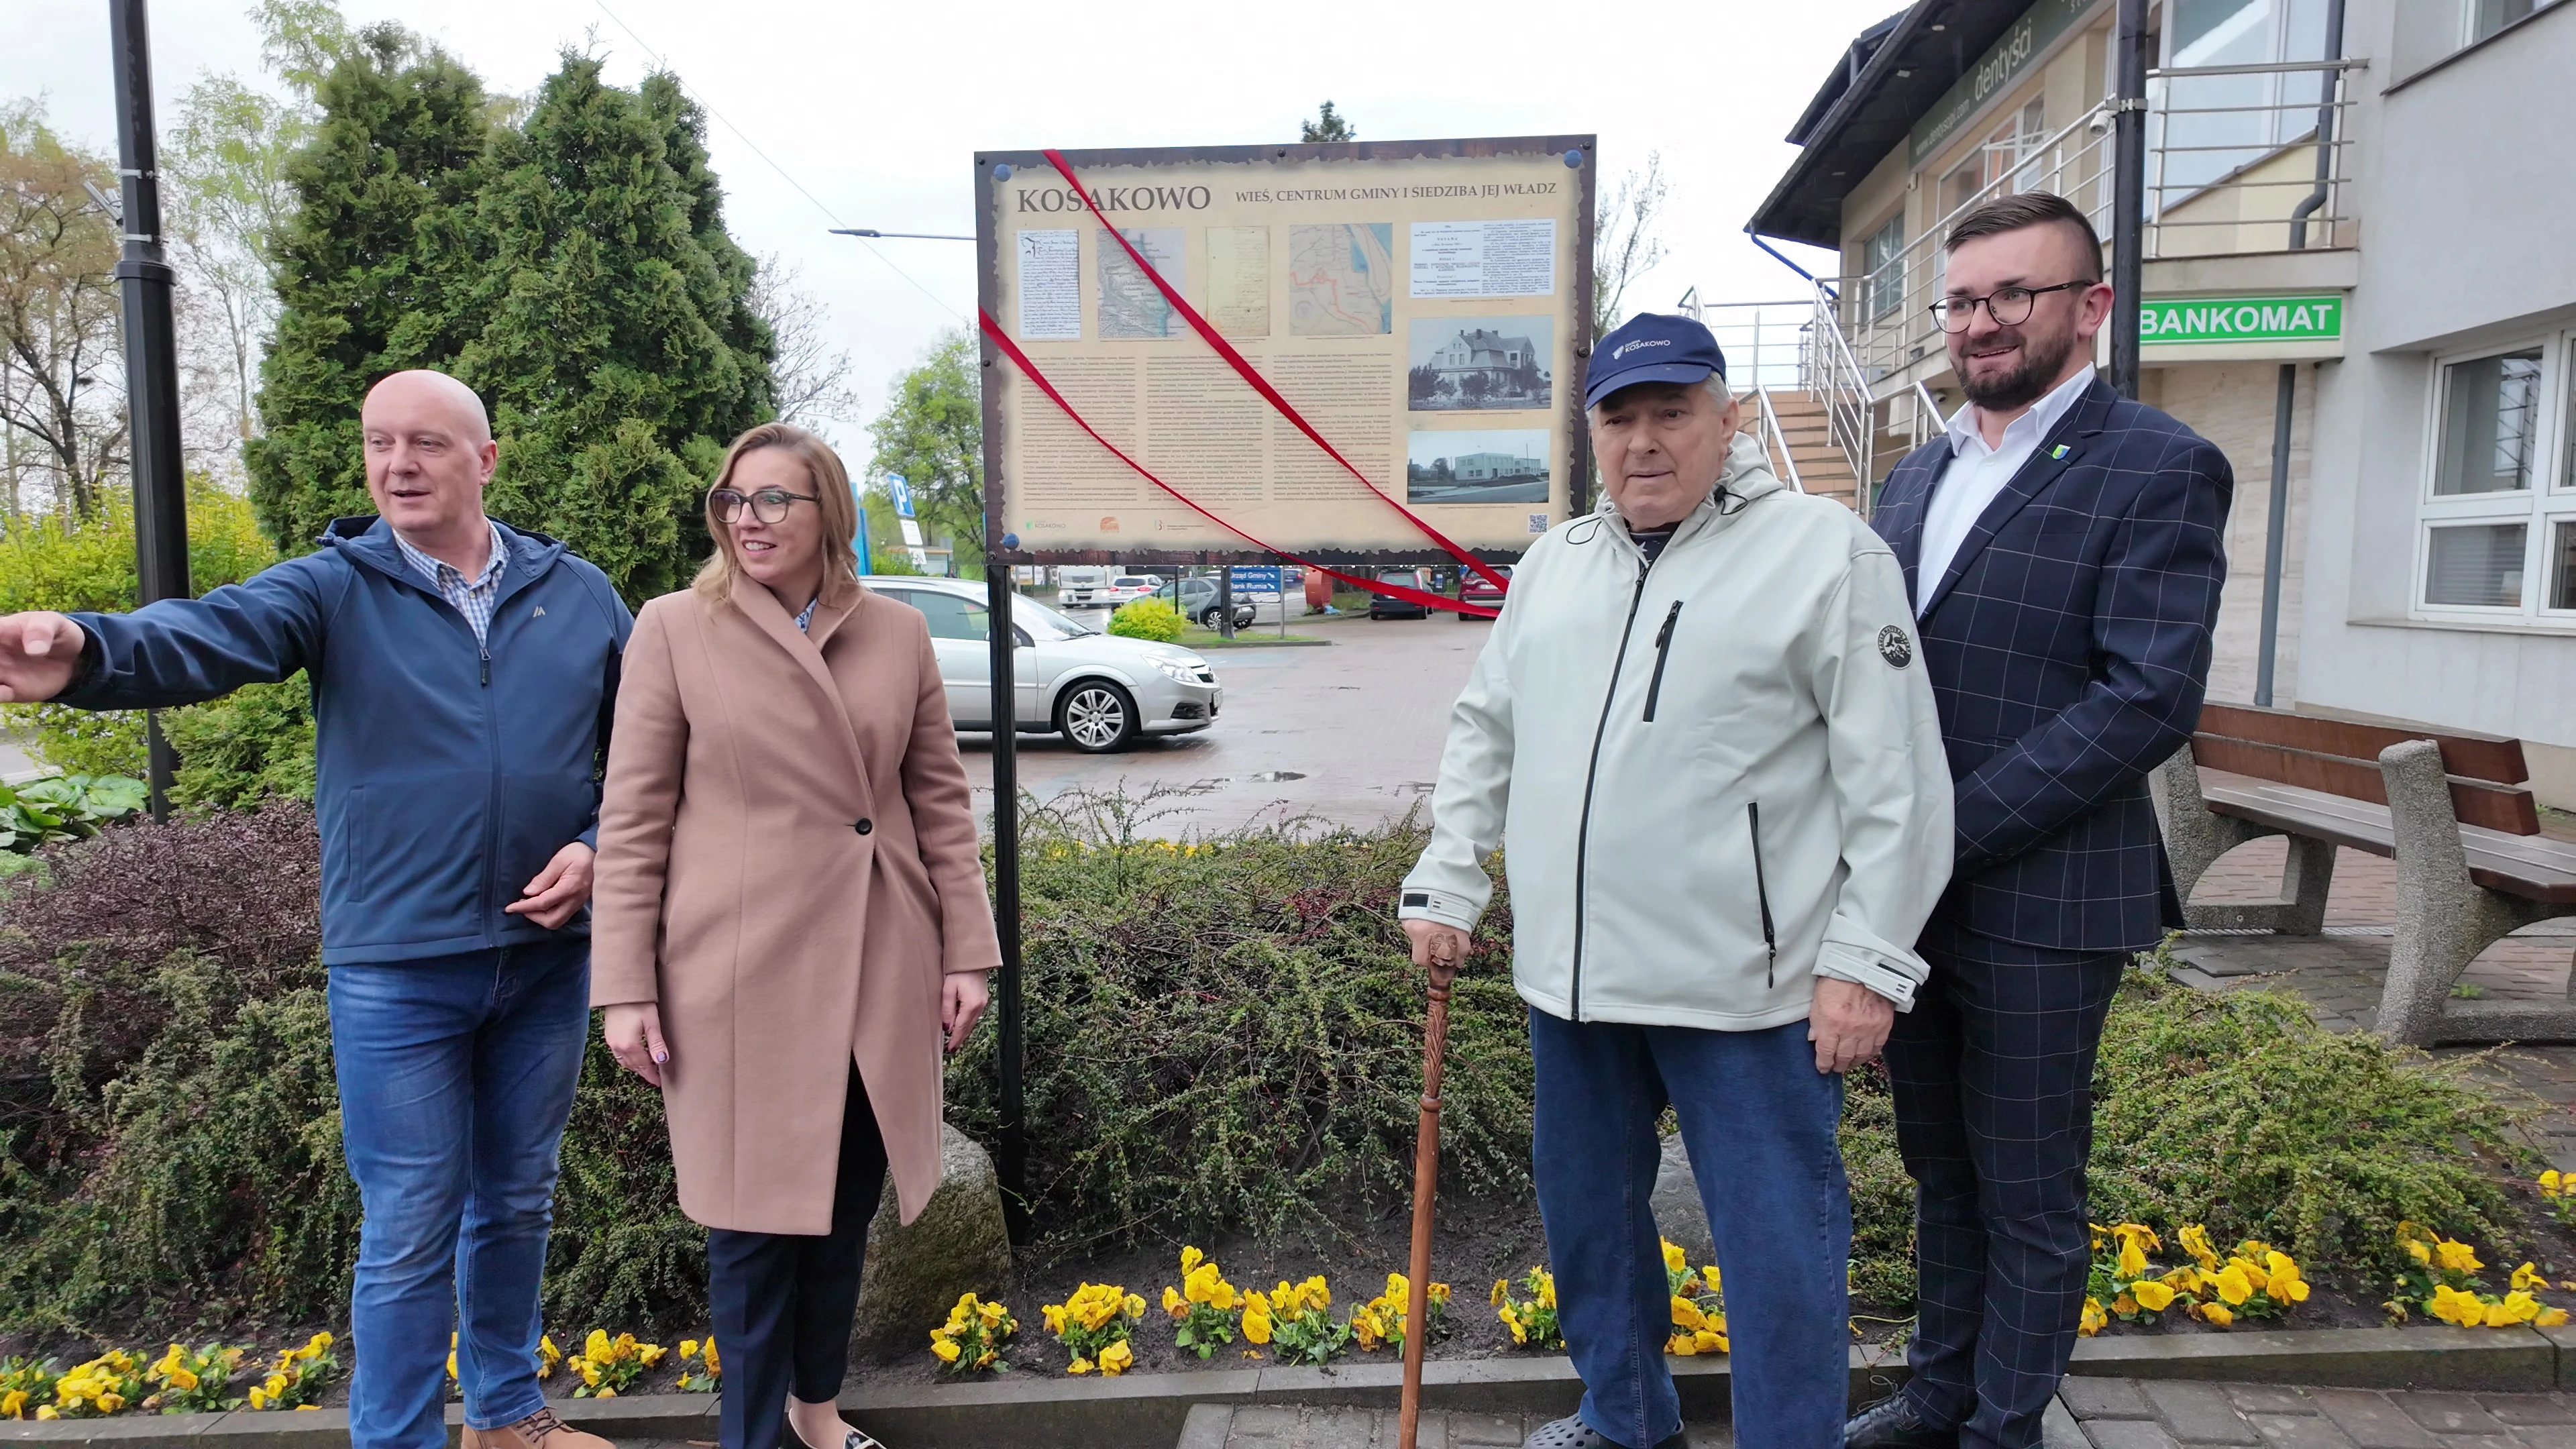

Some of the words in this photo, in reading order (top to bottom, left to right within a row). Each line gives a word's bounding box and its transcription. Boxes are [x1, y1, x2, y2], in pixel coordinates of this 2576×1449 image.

[1975, 17, 2031, 101] dentyści
[1017, 186, 1211, 212] KOSAKOWO
[1236, 189, 1273, 203] WIEŚ,
[1277, 189, 1346, 201] CENTRUM
[1350, 188, 1399, 199] GMINY
[1403, 187, 1407, 198] I
[1411, 185, 1478, 198] SIEDZIBA
[1481, 184, 1500, 198] JEJ
[1504, 182, 1557, 195] WŁADZ
[2141, 305, 2333, 334] BANKOMAT
[1625, 340, 1670, 353] KOSAKOWO
[893, 480, 908, 511] P
